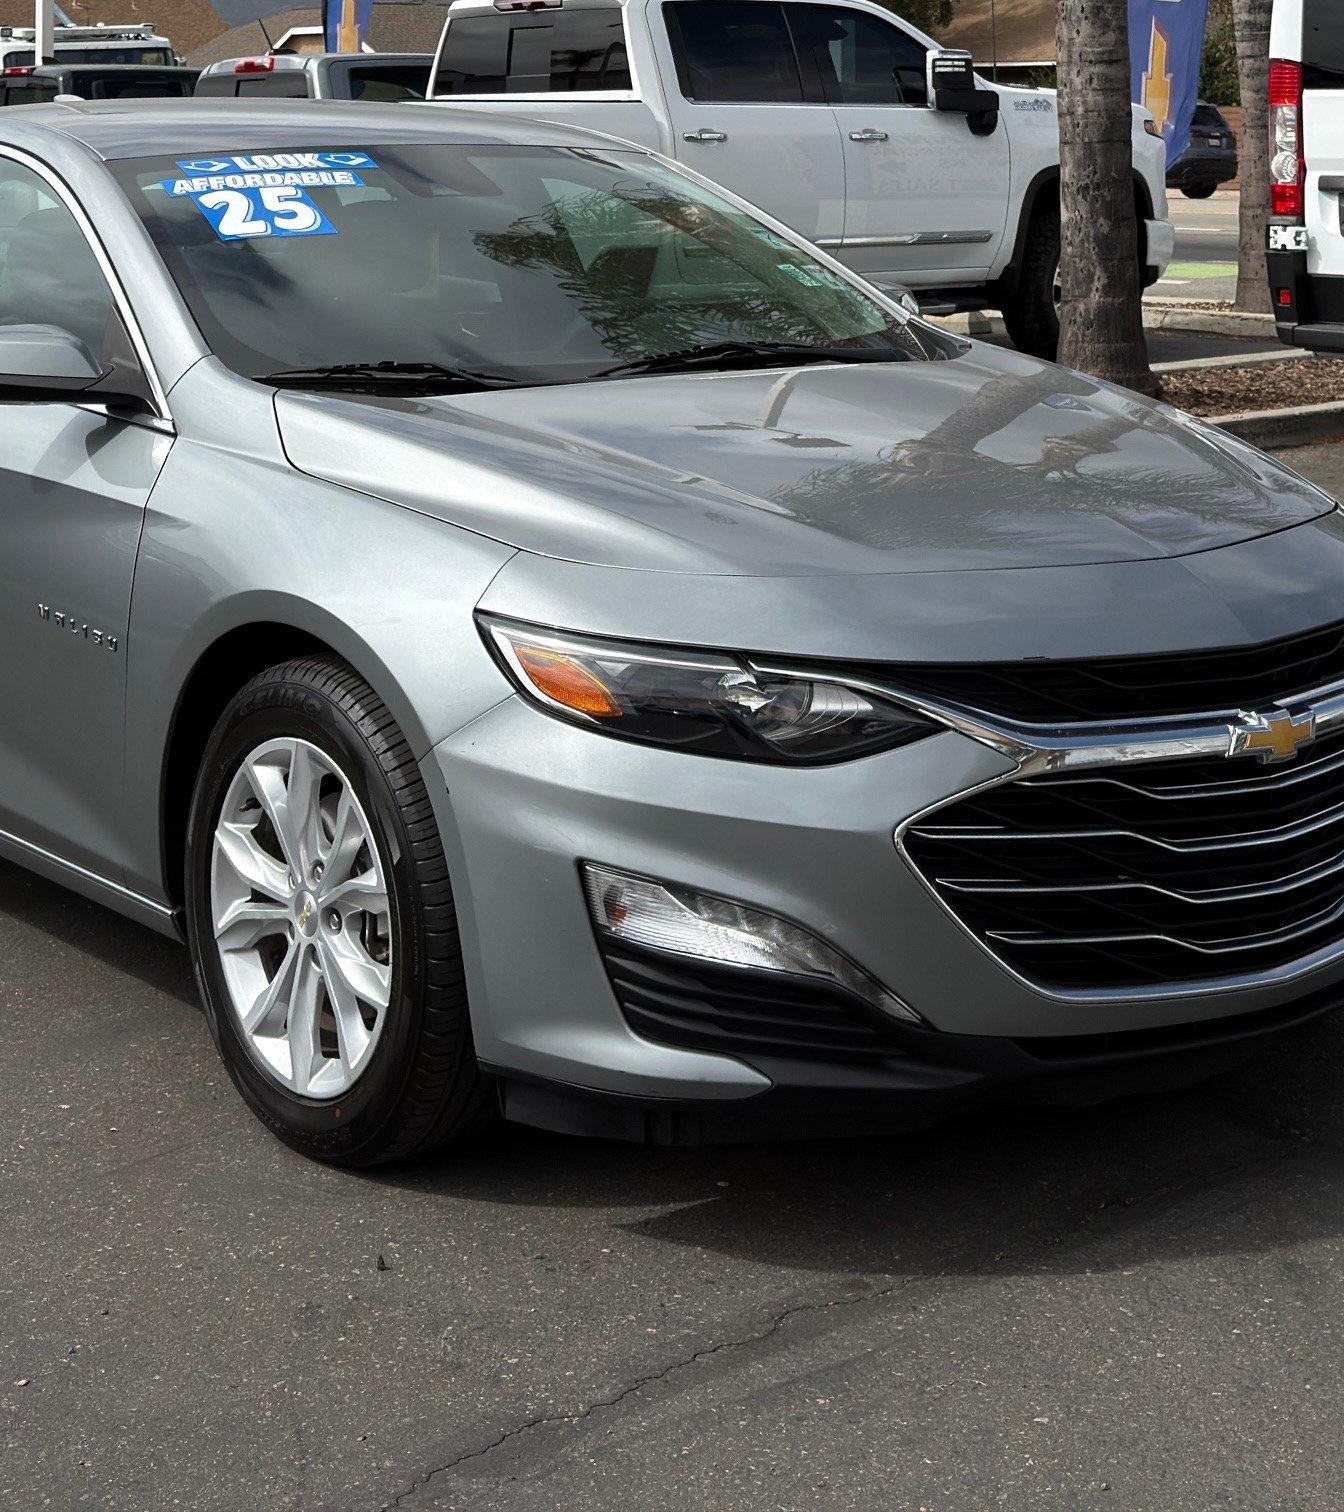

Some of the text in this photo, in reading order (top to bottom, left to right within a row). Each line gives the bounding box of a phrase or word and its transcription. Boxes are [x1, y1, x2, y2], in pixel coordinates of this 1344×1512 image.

[231, 153, 331, 171] LOOK
[173, 171, 356, 195] AFFORDABLE
[199, 186, 322, 236] 25
